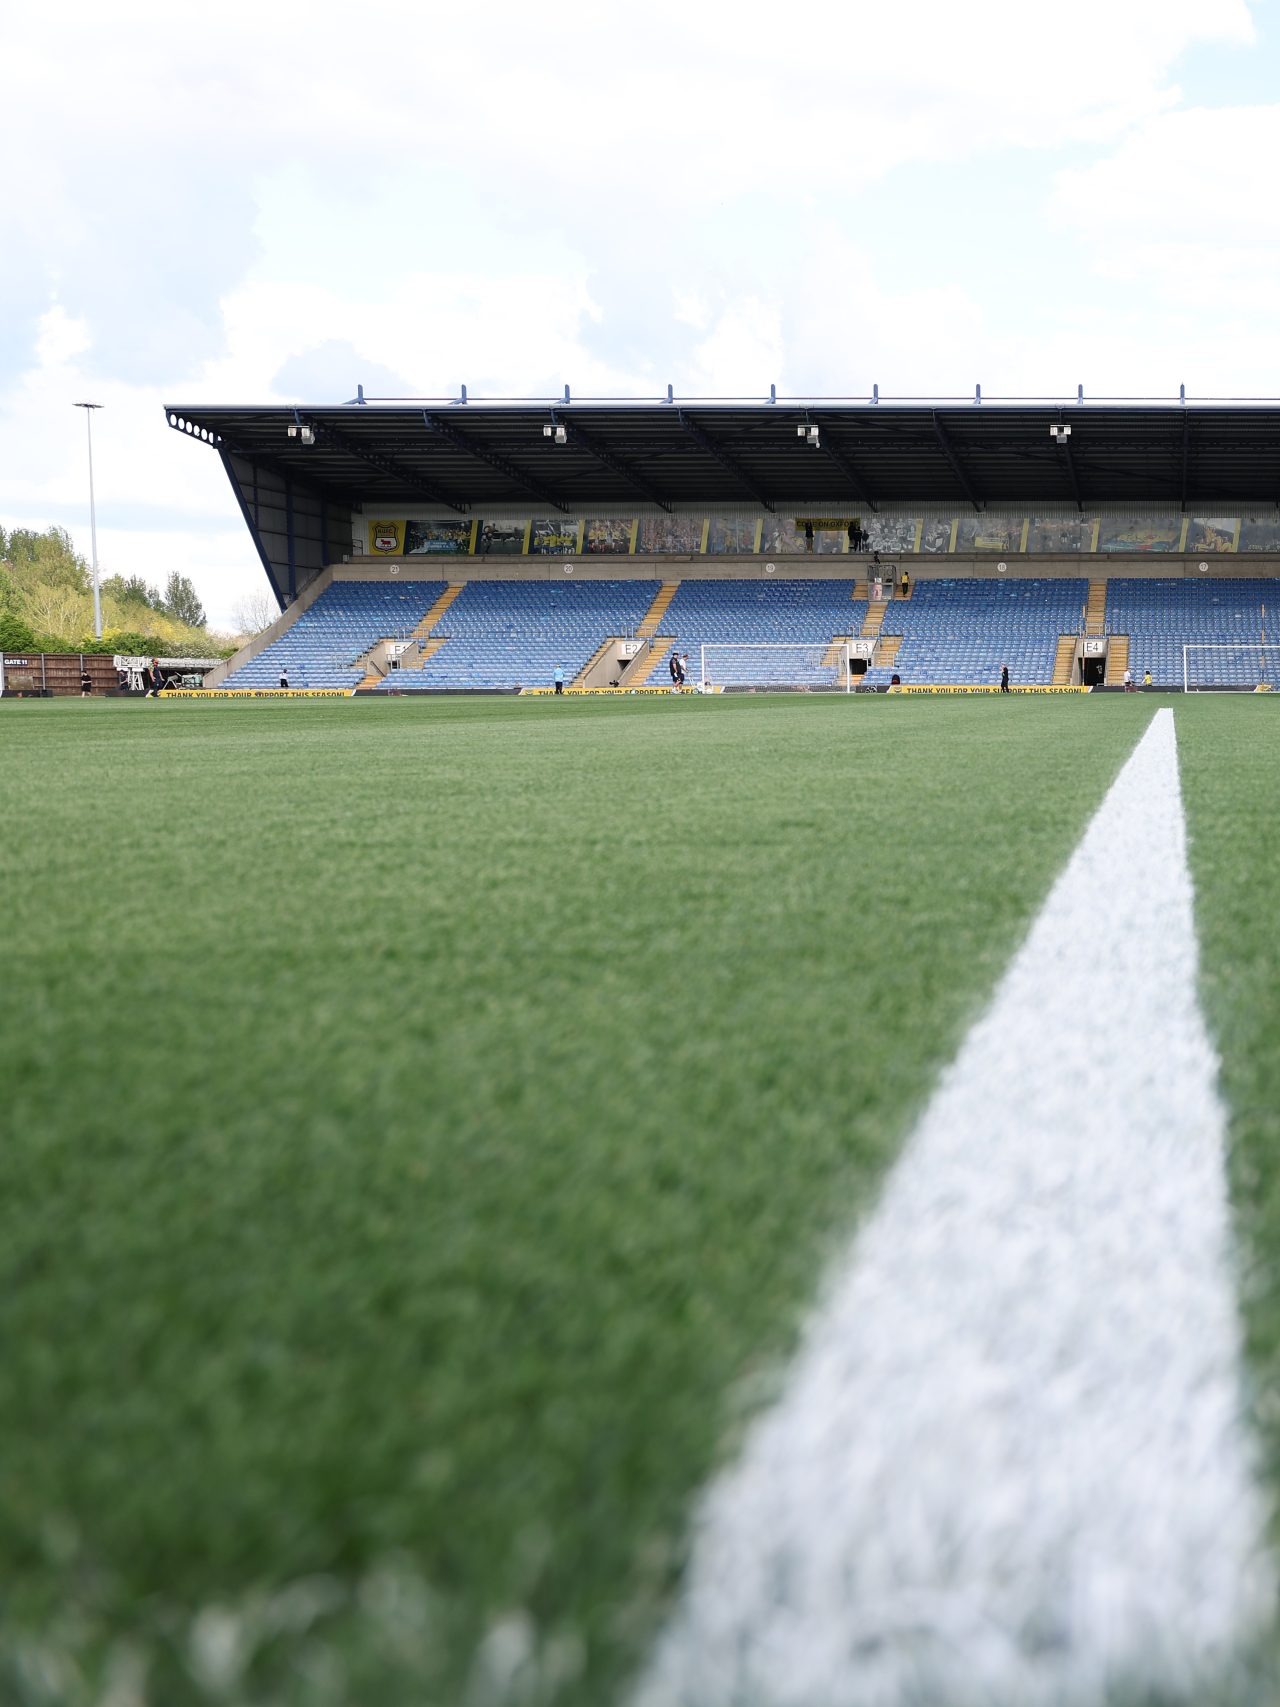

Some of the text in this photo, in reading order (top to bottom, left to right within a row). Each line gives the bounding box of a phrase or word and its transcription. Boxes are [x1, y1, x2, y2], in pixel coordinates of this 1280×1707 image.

[624, 644, 639, 655] E2
[855, 643, 869, 653] E3
[1086, 642, 1099, 652] E4
